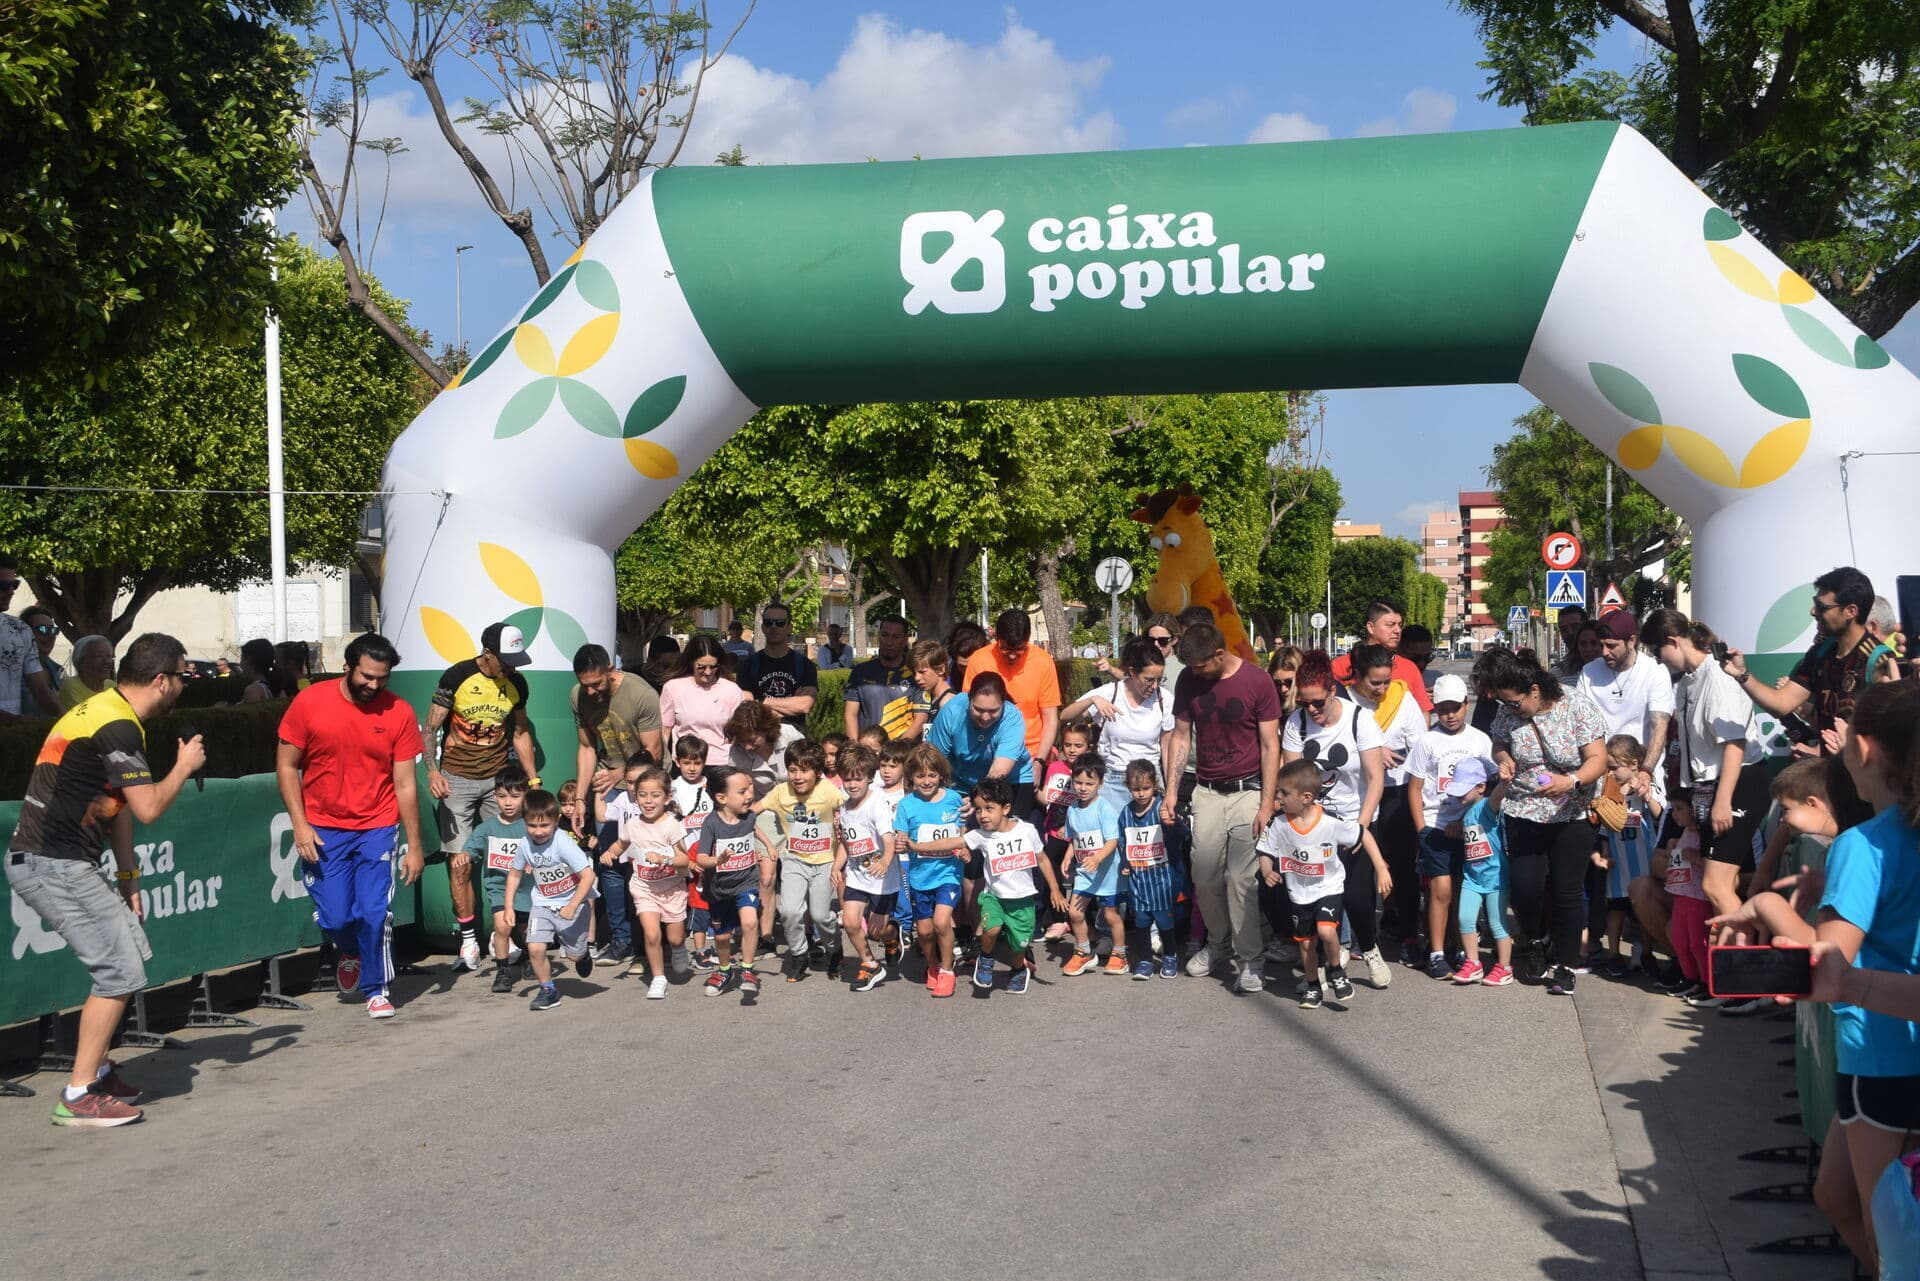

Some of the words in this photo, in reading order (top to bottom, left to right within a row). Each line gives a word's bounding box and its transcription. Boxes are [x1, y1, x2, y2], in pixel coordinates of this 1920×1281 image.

[1028, 204, 1217, 253] caixa
[1028, 243, 1325, 312] popular
[802, 828, 819, 839] 43
[933, 829, 949, 840] 60
[1136, 831, 1149, 843] 47
[501, 843, 518, 854] 42
[996, 838, 1023, 856] 317
[101, 840, 174, 882] axa
[1292, 849, 1309, 861] 49
[540, 868, 565, 882] 336
[140, 871, 222, 920] ular
